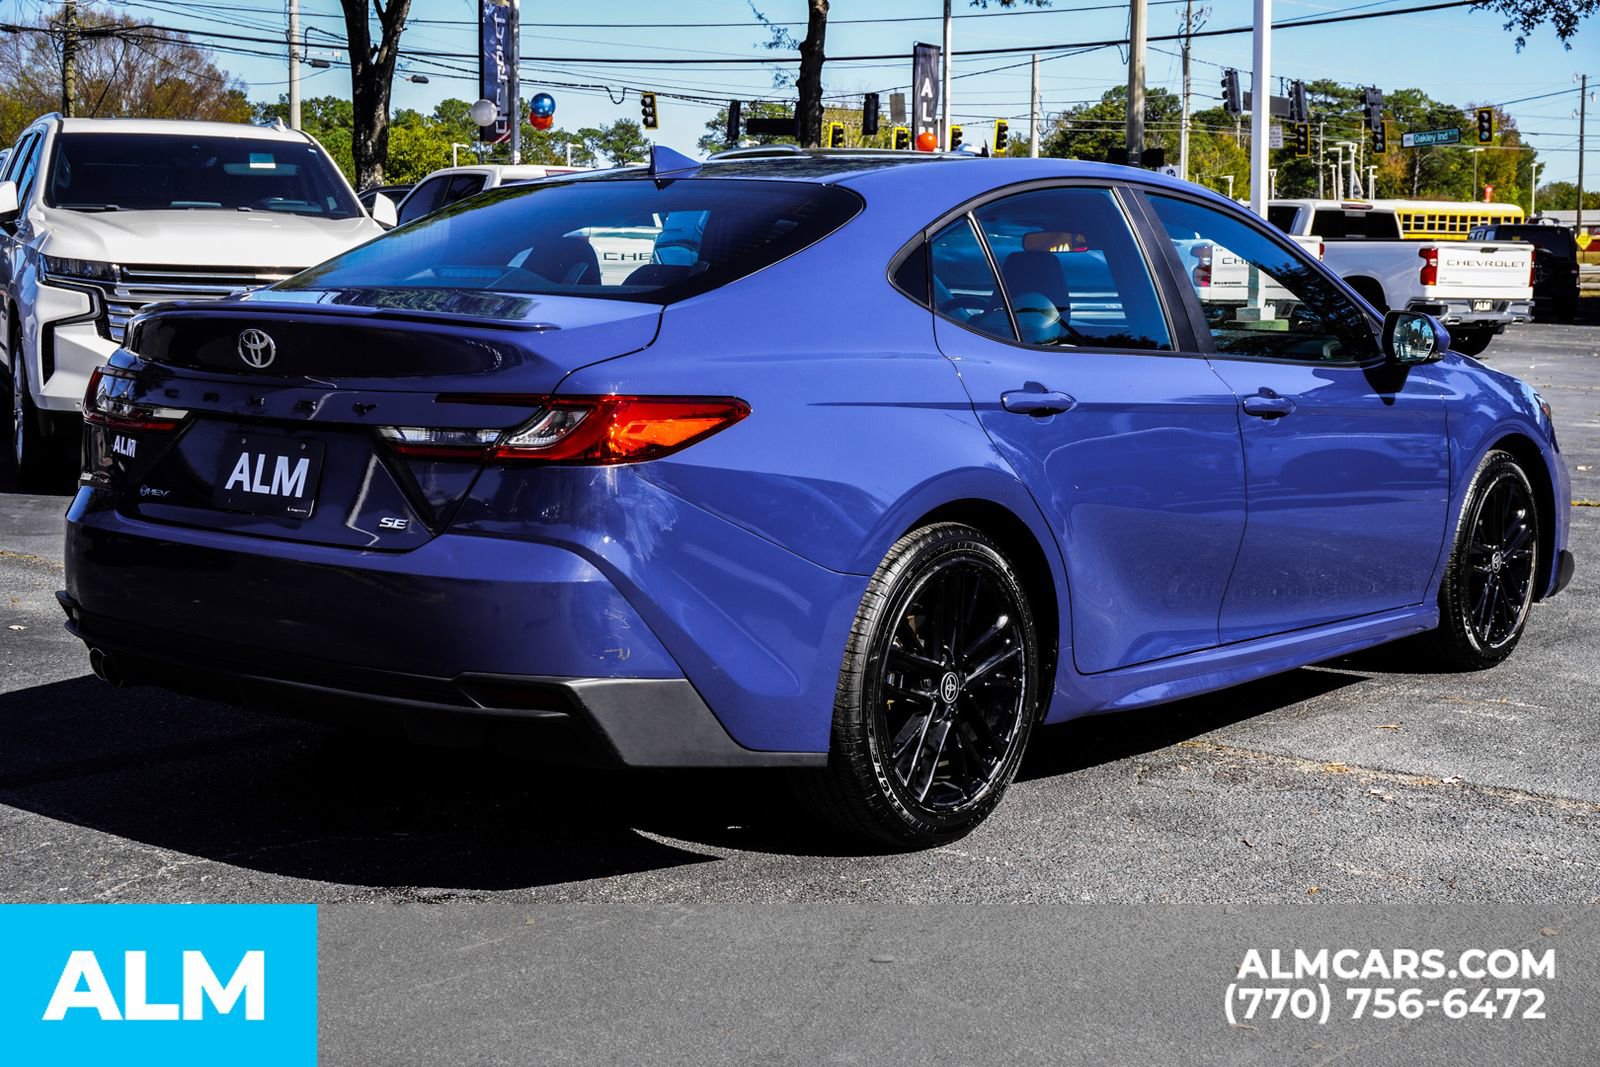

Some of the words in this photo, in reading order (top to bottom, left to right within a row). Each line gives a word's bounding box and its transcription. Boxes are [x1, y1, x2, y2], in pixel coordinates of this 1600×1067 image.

[1414, 132, 1437, 144] Oakley
[1437, 131, 1449, 141] Ind
[1446, 259, 1525, 268] CHEVROLET
[1474, 301, 1492, 311] ALM
[112, 434, 137, 458] ALM
[224, 451, 310, 499] ALM
[378, 516, 409, 530] SE
